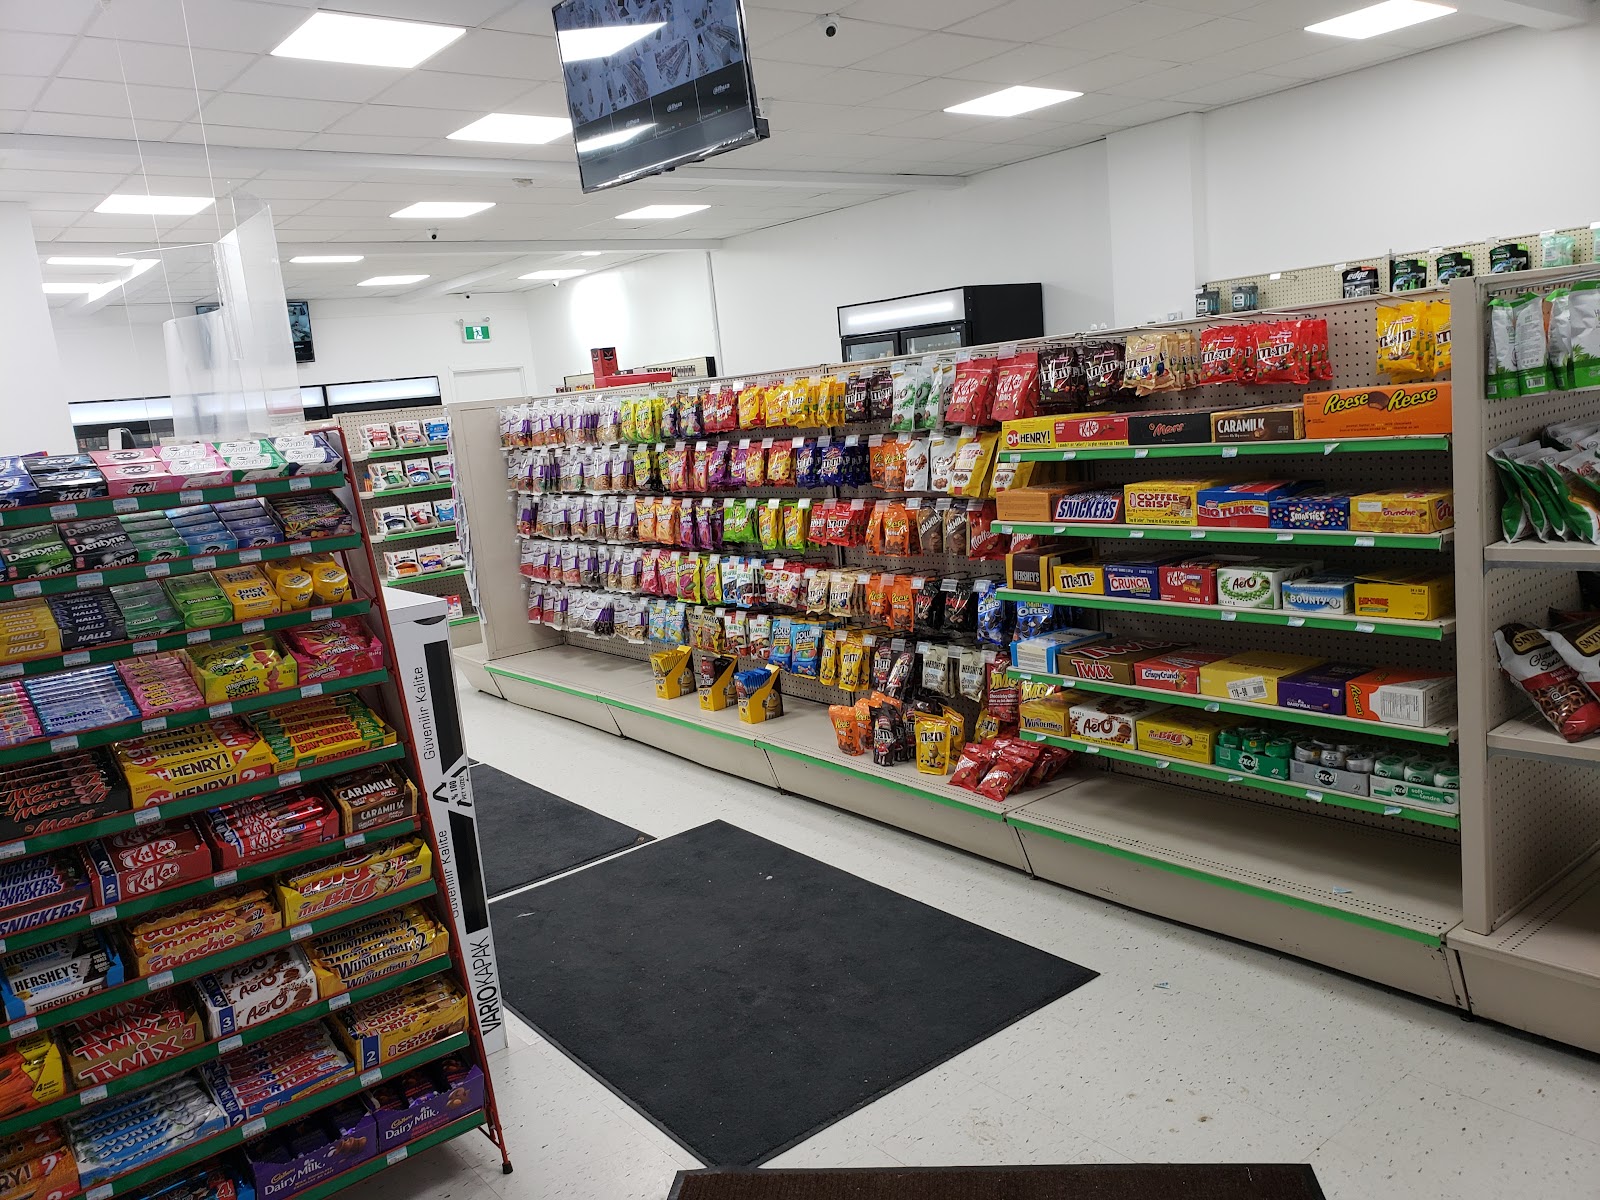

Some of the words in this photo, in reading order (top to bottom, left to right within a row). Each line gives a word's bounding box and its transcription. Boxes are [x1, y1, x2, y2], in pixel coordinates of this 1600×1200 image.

[1347, 270, 1368, 280] edge
[1323, 393, 1369, 415] Reese
[1387, 389, 1437, 412] Reese
[1152, 422, 1185, 437] Mars
[1217, 417, 1265, 433] CARAMILK
[1007, 432, 1020, 444] OH
[1020, 430, 1050, 444] HENRY!
[117, 464, 156, 475] excel
[59, 488, 91, 501] excel
[127, 481, 158, 494] excel
[1057, 500, 1118, 519] SNICKERS
[1198, 507, 1220, 518] BIG
[1221, 505, 1256, 517] TURK
[1289, 510, 1325, 522] SMARTIES
[65, 520, 118, 536] Dentyne
[0, 528, 53, 546] Dentyne
[74, 534, 127, 554] Dentyne
[7, 544, 63, 561] Dentyne
[1014, 571, 1040, 583] HERSHEY'S
[1111, 578, 1148, 589] CRUNCH
[186, 595, 220, 605] DOUBLEMINT
[978, 601, 1000, 612] OREO
[1290, 594, 1327, 605] BOUNTY
[72, 609, 100, 617] HALLS
[75, 615, 102, 623] HALLS
[1017, 607, 1050, 617] OREO
[7, 624, 37, 632] HALLS
[77, 622, 105, 632] HALLS
[774, 627, 791, 635] JOLLY
[10, 632, 40, 641] HALLS
[78, 630, 112, 642] HALLS
[8, 642, 45, 654] HALLS
[415, 666, 427, 703] Kalite
[1349, 684, 1364, 716] Reese's
[50, 708, 103, 722] mentos
[423, 705, 436, 760] Güvenilir
[297, 731, 362, 753] EAT-MORE
[172, 752, 233, 778] HENRY!
[1238, 757, 1259, 769] excel
[1314, 771, 1338, 783] excel
[339, 778, 396, 800] CARAMILK
[1392, 785, 1408, 796] excel
[14, 798, 70, 822] Mars
[360, 800, 404, 820] CARAMILK
[32, 809, 96, 835] Mars
[283, 824, 305, 834] CHUNKY
[438, 829, 452, 865] Kalite
[129, 841, 175, 869] KitKat
[129, 865, 178, 893] KitKat
[106, 884, 115, 894] 2
[1, 898, 84, 935] SNICKERS
[333, 938, 412, 979] WUNDERBAR
[14, 963, 78, 992] HERSHEY'S
[342, 961, 407, 988] WUNDERBAR
[467, 935, 502, 1037] VARIOKAPAK
[222, 1017, 232, 1028] 3
[367, 1007, 407, 1027] CRISP
[380, 1013, 419, 1034] CRISP
[183, 1028, 195, 1040] 4
[74, 1023, 168, 1062] TWIX
[79, 1035, 184, 1082] TWIX
[366, 1051, 376, 1062] 2
[36, 1082, 43, 1093] 4
[385, 1120, 413, 1140] Dairy
[414, 1110, 439, 1125] Milk
[264, 1174, 296, 1196] Dairy
[298, 1162, 322, 1179] Milk
[216, 1183, 232, 1199] 4
